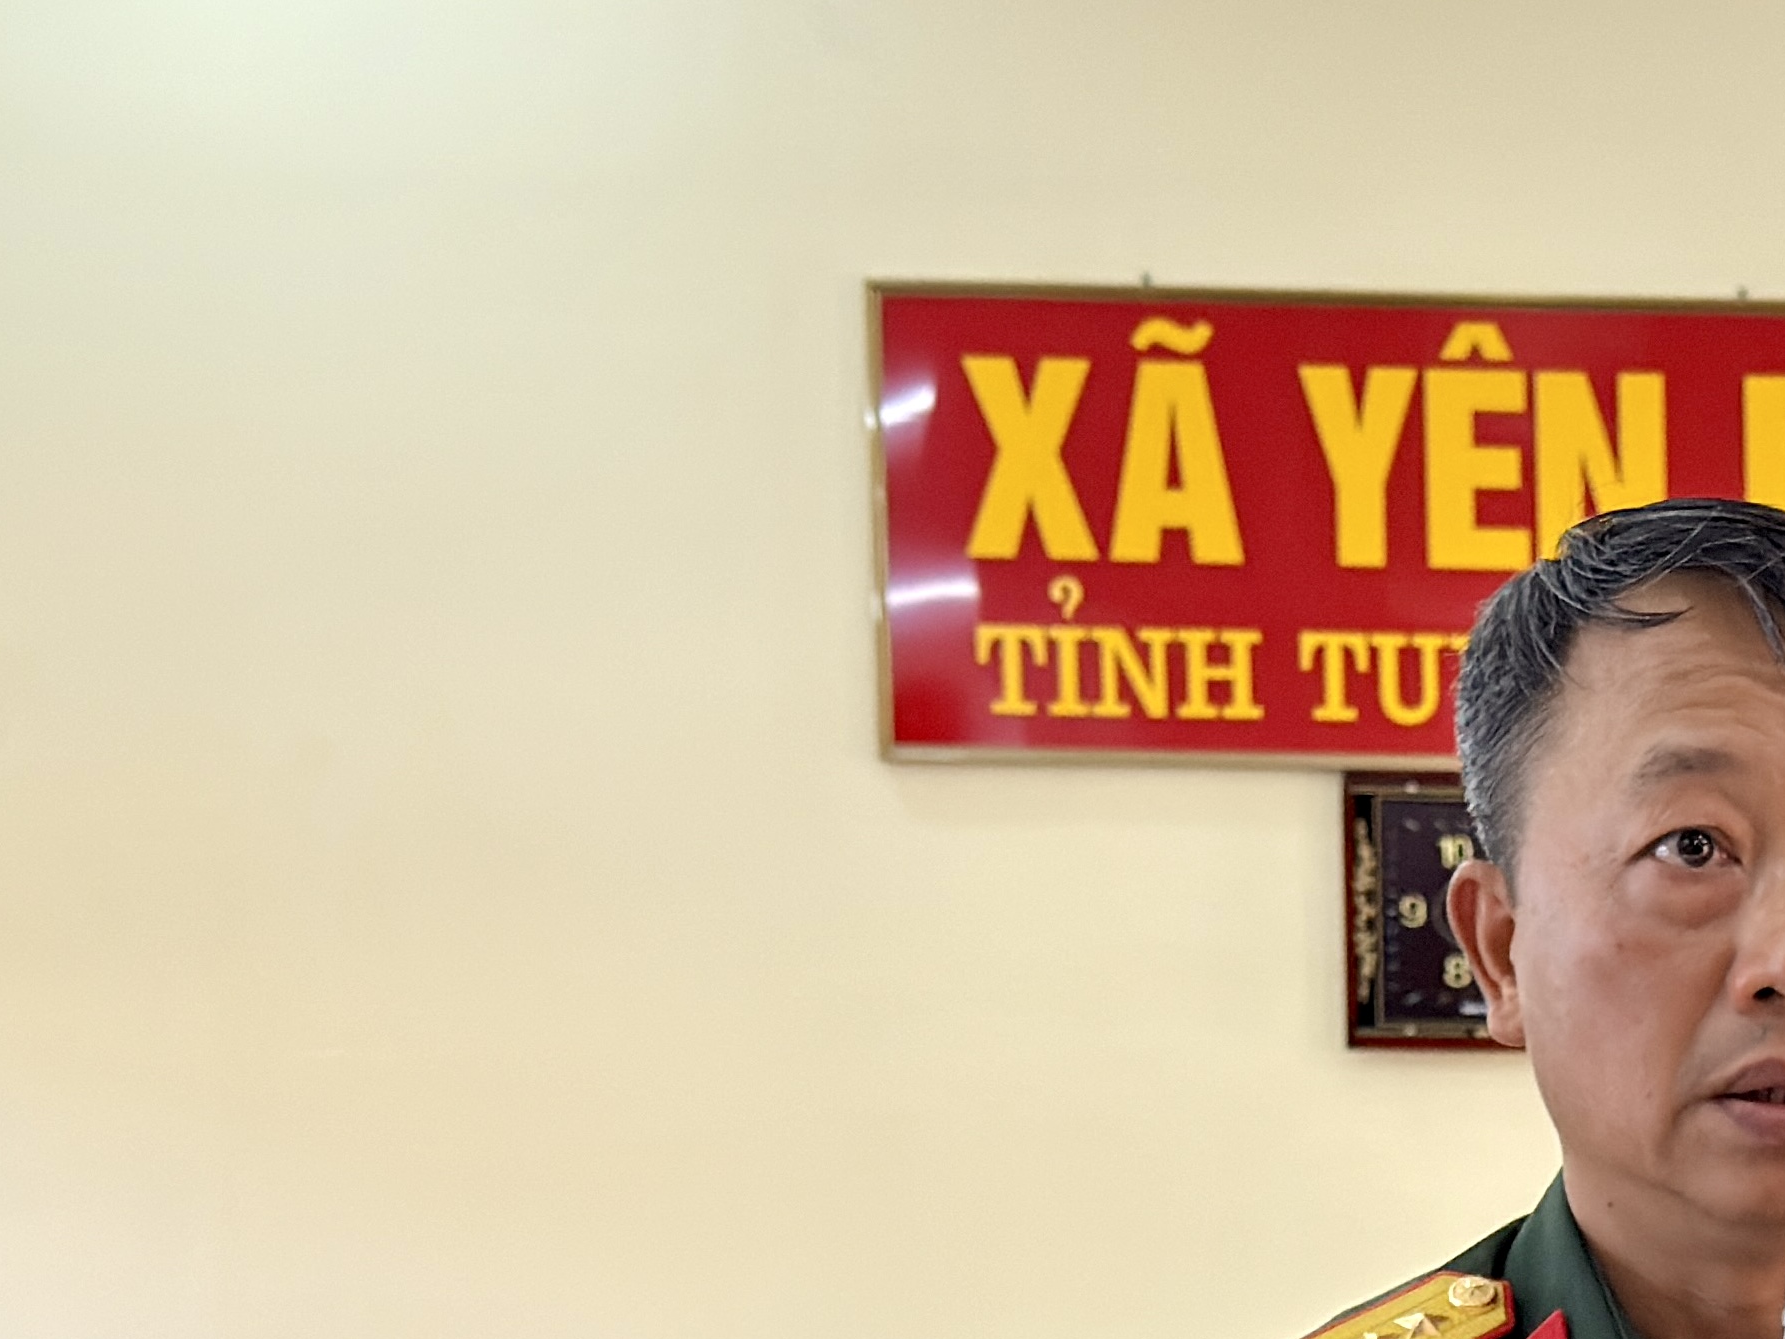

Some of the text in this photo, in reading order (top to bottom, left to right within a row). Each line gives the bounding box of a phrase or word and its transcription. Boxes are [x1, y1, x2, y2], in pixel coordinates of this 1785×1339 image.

[963, 319, 1243, 564] XÃ
[1299, 323, 1667, 573] YÊN
[975, 576, 1264, 719] TỈNH
[1399, 892, 1428, 928] 9
[1443, 952, 1473, 988] 8
